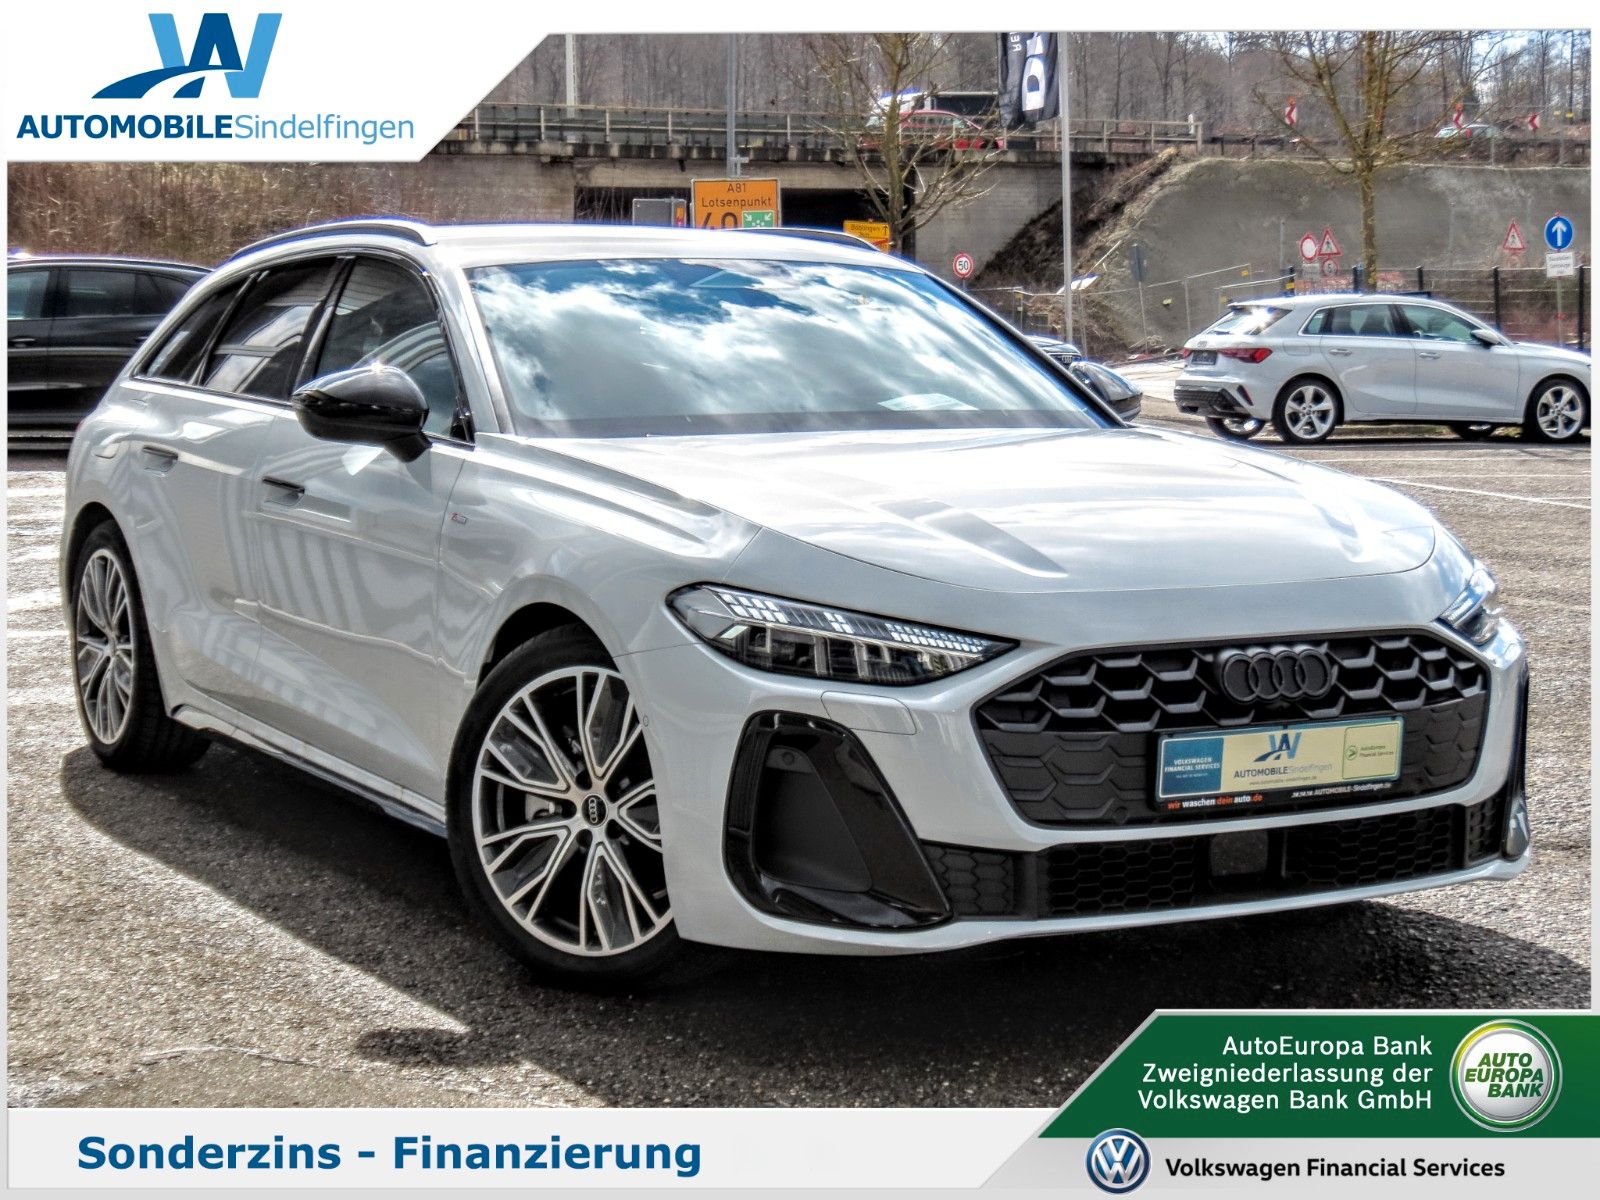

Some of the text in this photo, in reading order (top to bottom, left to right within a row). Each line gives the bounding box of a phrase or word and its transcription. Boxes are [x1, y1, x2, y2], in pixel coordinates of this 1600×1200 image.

[726, 183, 747, 193] A81
[702, 197, 772, 209] Lotsenpunkt
[957, 260, 969, 272] 50
[1173, 756, 1212, 765] VOLKSWAGEN
[1164, 762, 1221, 773] FINANCIAL SERVICES
[1167, 800, 1181, 809] wir
[1182, 798, 1216, 808] waschen
[1216, 796, 1233, 805] dein
